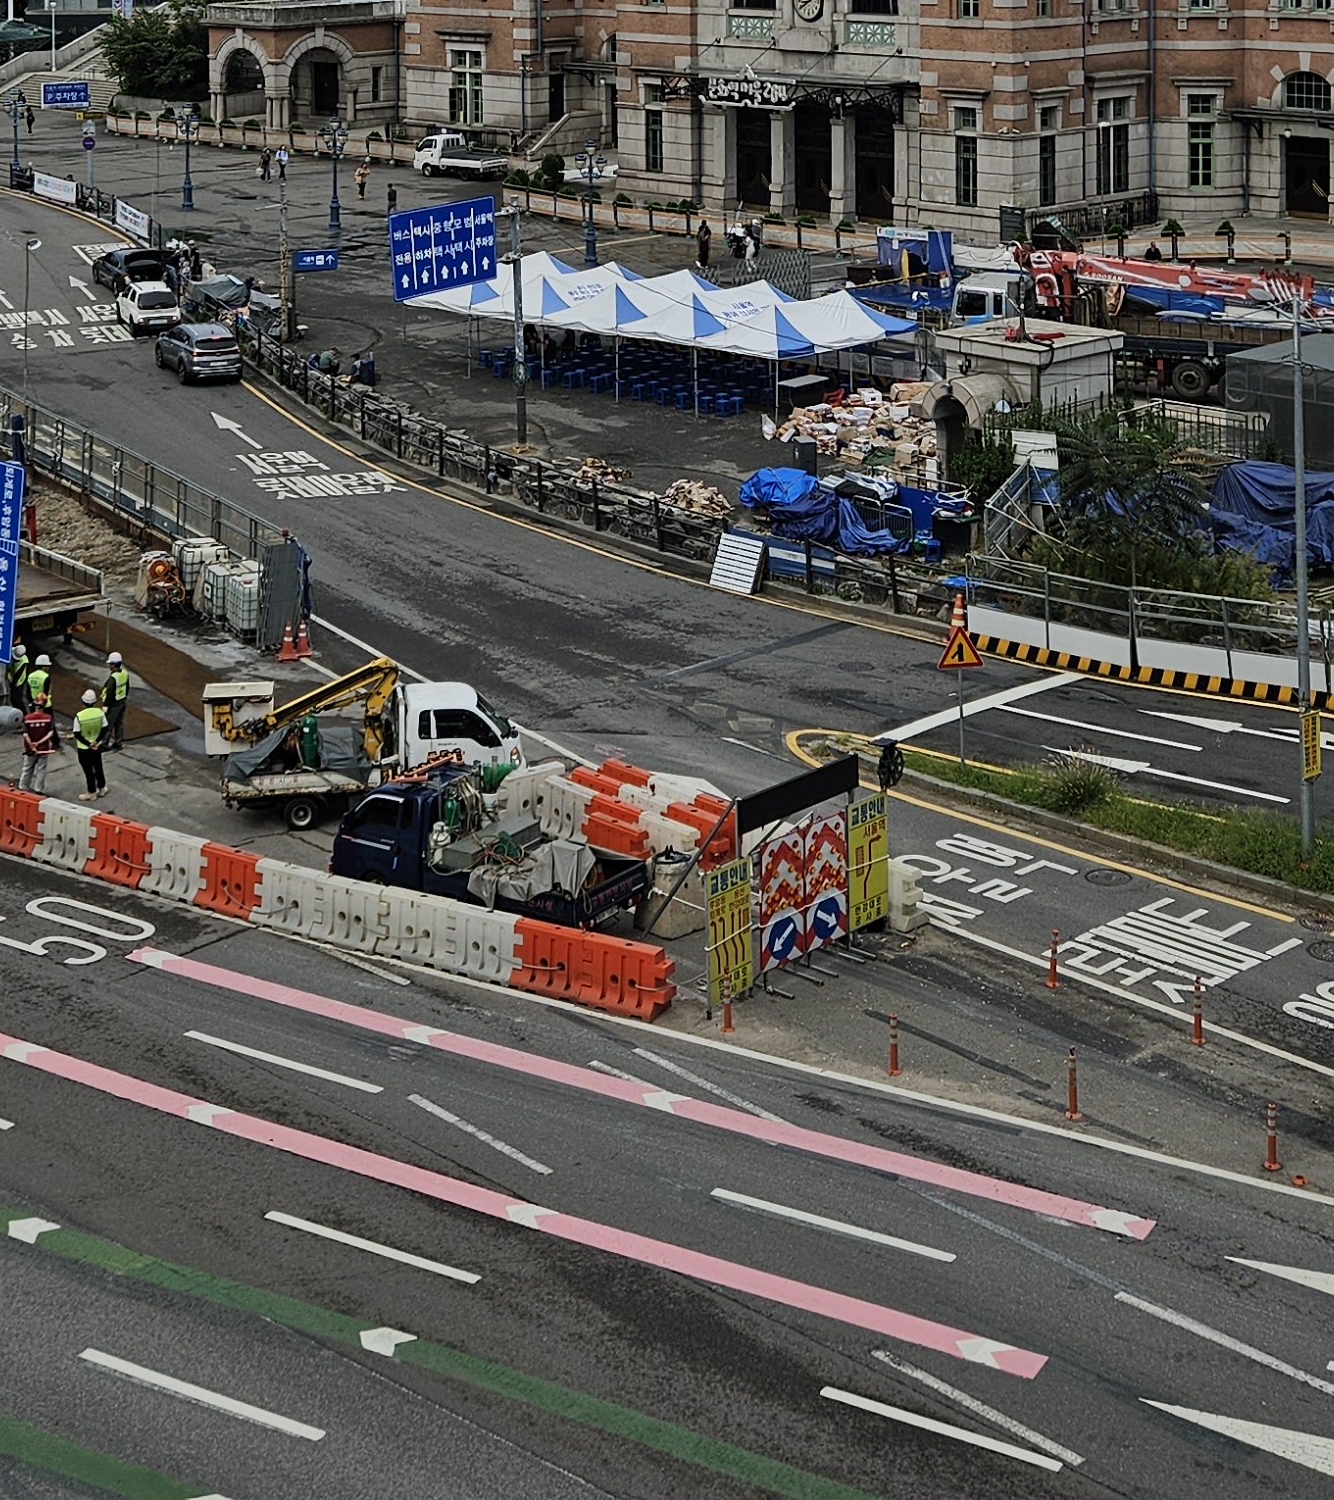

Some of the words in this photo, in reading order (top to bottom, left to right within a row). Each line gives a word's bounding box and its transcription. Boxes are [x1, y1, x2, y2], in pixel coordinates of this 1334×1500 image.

[474, 211, 494, 227] 서울역
[393, 229, 411, 241] 버스
[475, 235, 494, 249] 주차장
[394, 252, 412, 266] 전용
[10, 328, 76, 351] 승차
[235, 450, 332, 476] 서울역
[252, 471, 409, 501] 롯데아울렛
[851, 797, 885, 827] 교통안내
[862, 819, 886, 839] 서울역
[710, 862, 748, 896] 교통안내
[854, 896, 883, 917] 한강대로
